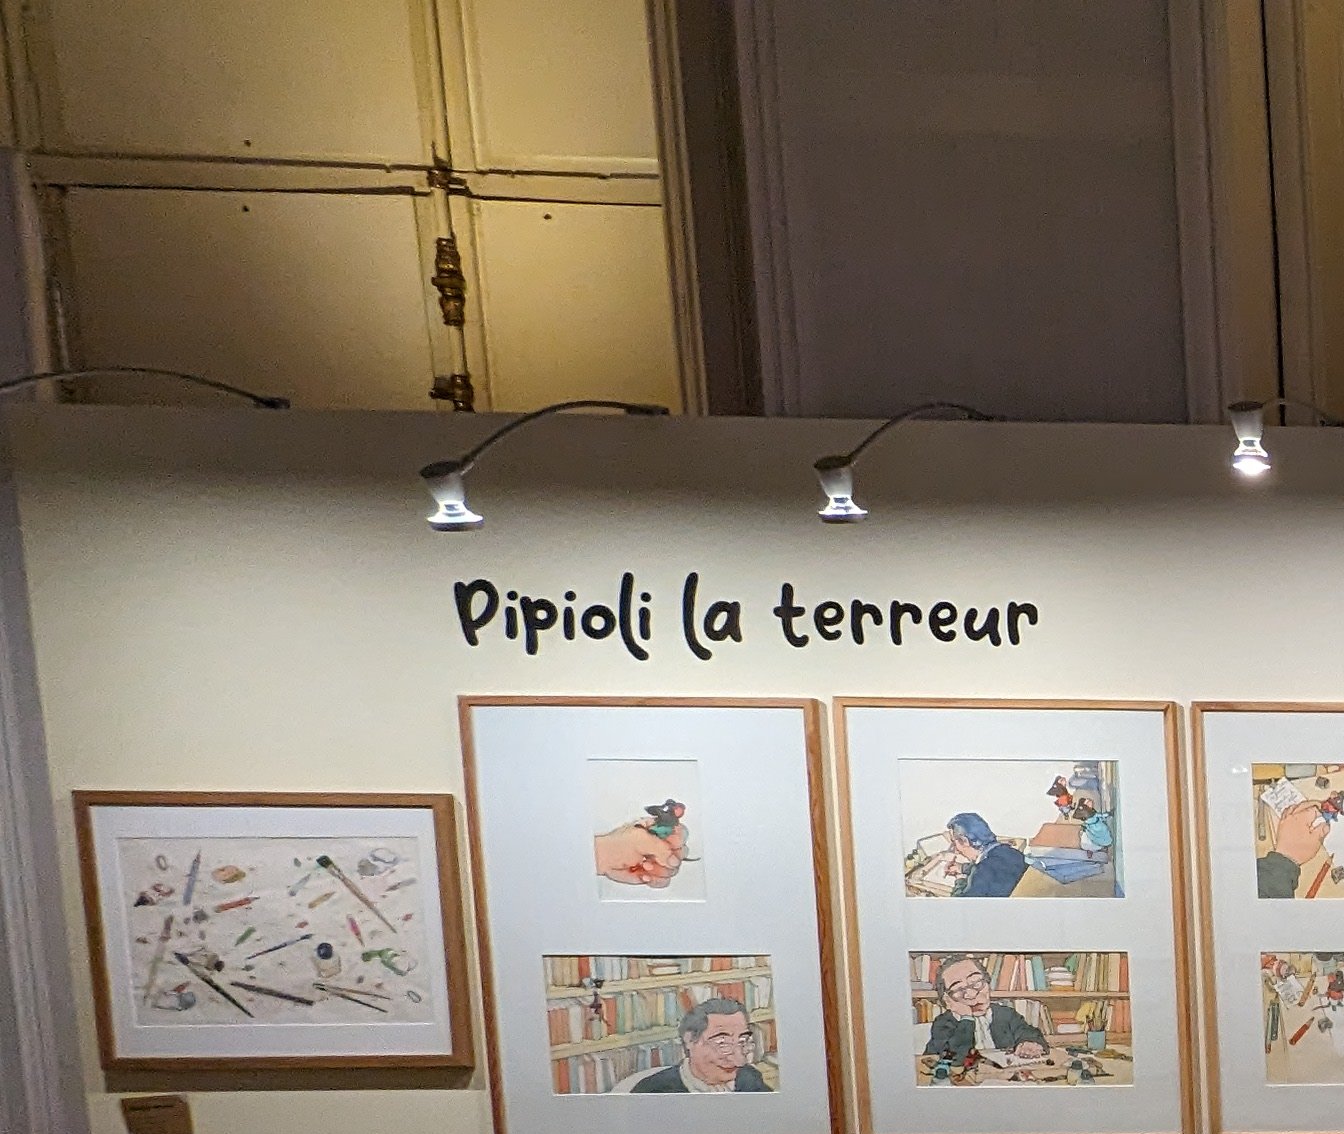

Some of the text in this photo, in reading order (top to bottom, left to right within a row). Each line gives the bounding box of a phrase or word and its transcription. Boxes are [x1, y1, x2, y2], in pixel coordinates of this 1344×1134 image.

[453, 571, 1039, 661] Pipioli la terreur
